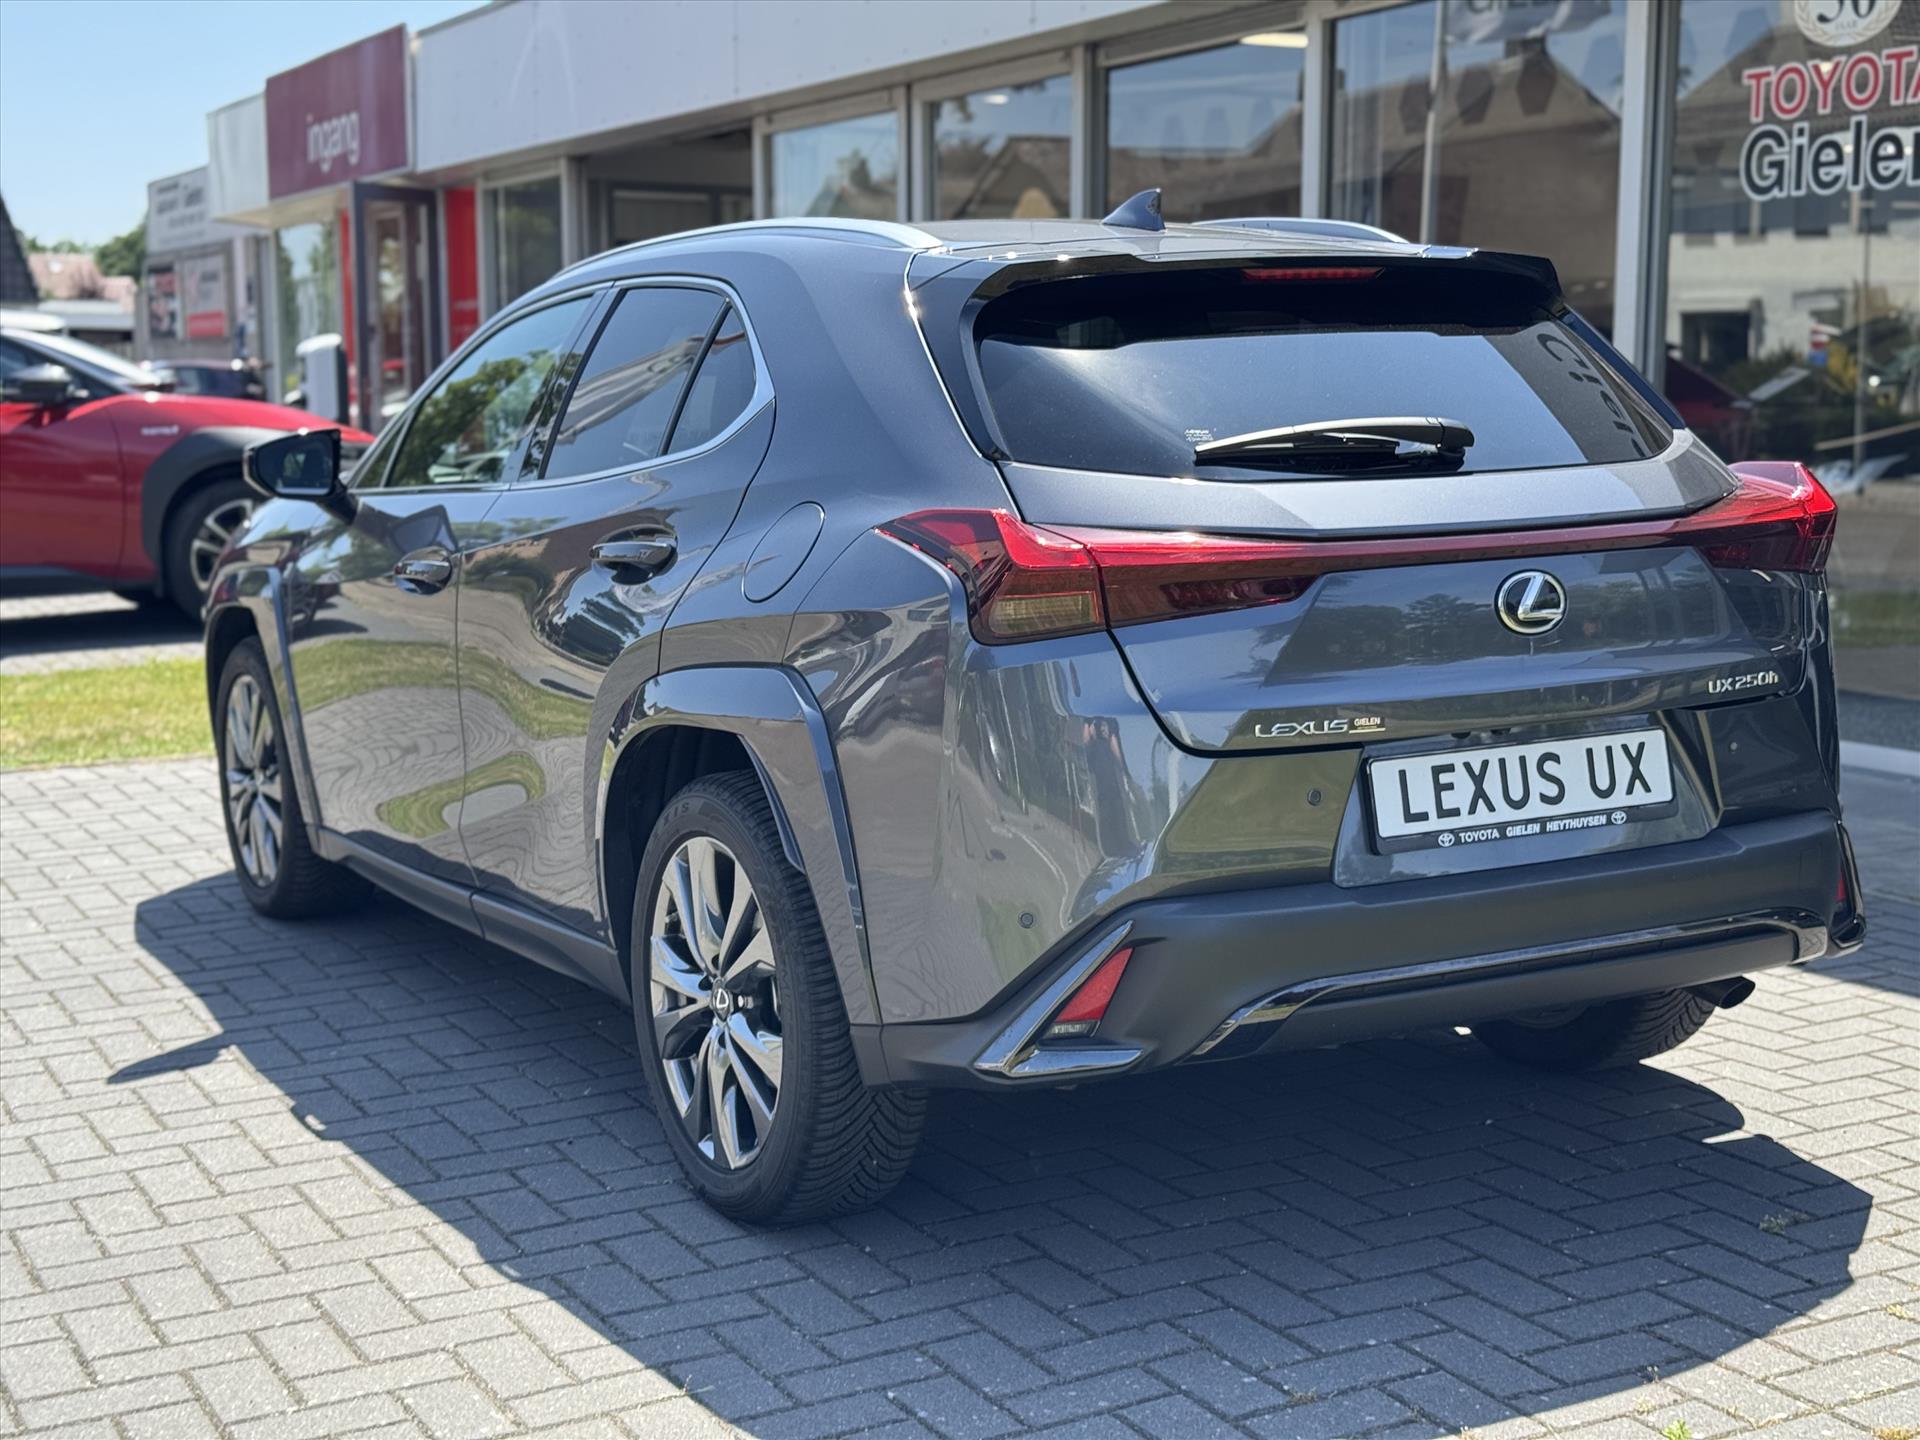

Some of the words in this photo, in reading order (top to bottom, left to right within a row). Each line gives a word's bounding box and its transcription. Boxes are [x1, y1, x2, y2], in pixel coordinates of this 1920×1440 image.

[1744, 46, 1920, 123] TOYOT
[306, 112, 360, 174] ingang
[1740, 116, 1920, 200] Giele
[1255, 720, 1348, 737] LEXUS
[1398, 752, 1566, 824] LEXUS
[1585, 742, 1652, 799] UX
[1459, 828, 1500, 844] TOYOTA
[1506, 823, 1541, 837] GIELEN
[1546, 814, 1607, 831] HEYTHUYSEN
